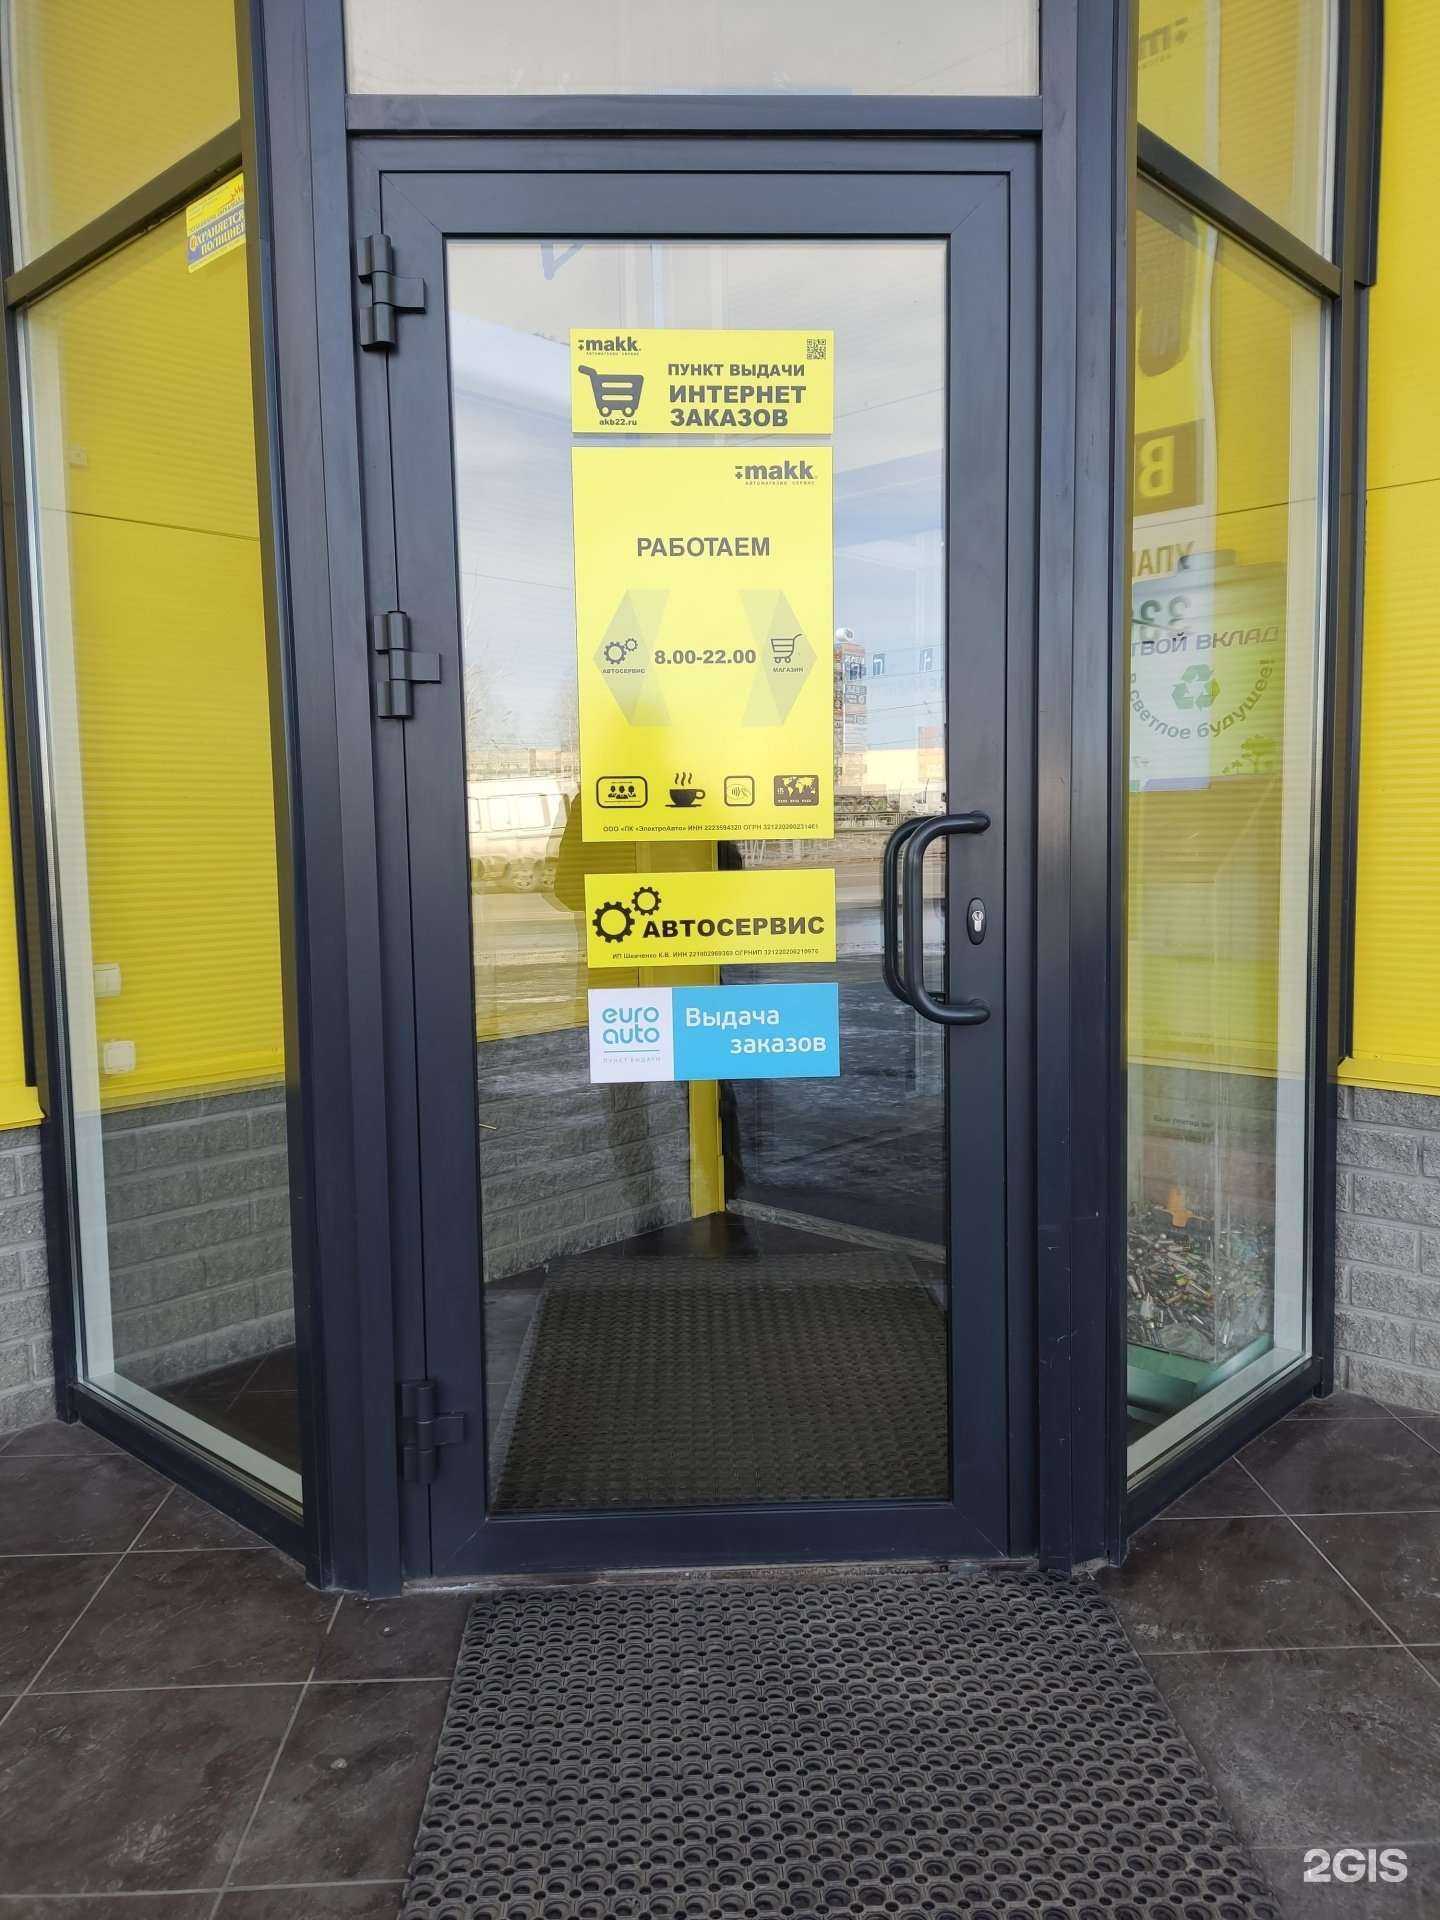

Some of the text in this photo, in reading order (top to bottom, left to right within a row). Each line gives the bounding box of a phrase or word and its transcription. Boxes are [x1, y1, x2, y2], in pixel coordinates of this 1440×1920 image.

[668, 363, 805, 379] ПУНКТ ВЫДАЧИ
[669, 385, 807, 404] ИНТЕРНЕТ
[599, 418, 637, 426] akb22.ru
[670, 408, 788, 427] ЗАКАЗОВ
[637, 536, 769, 557] РАБОТАЕМ
[1197, 626, 1279, 650] ВКЛАД
[654, 649, 756, 665] 8.00-22.00
[642, 916, 825, 938] АВТОСЕРВИС
[602, 1006, 660, 1024] euro
[686, 1007, 780, 1030] Выдача
[602, 1027, 660, 1044] auto
[730, 1037, 826, 1054] заказов
